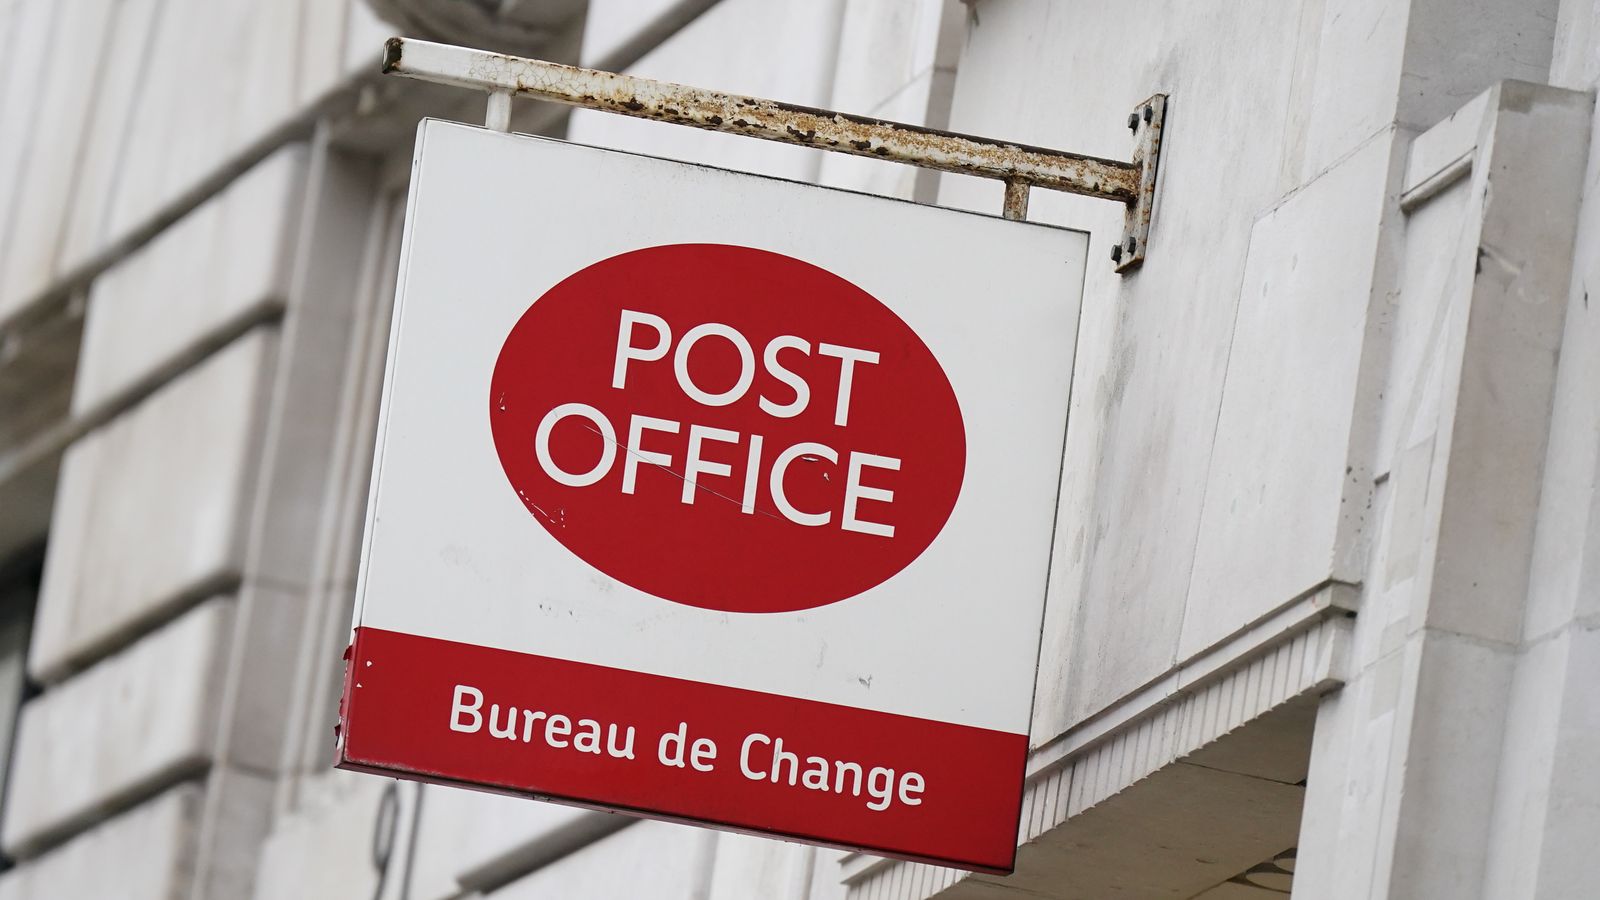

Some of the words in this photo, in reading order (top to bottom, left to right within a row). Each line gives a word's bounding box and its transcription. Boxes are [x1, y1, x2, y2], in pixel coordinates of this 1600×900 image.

[611, 308, 881, 427] POST
[534, 402, 902, 538] OFFICE
[449, 684, 636, 760] Bureau
[657, 721, 717, 772] de
[739, 733, 926, 812] Change
